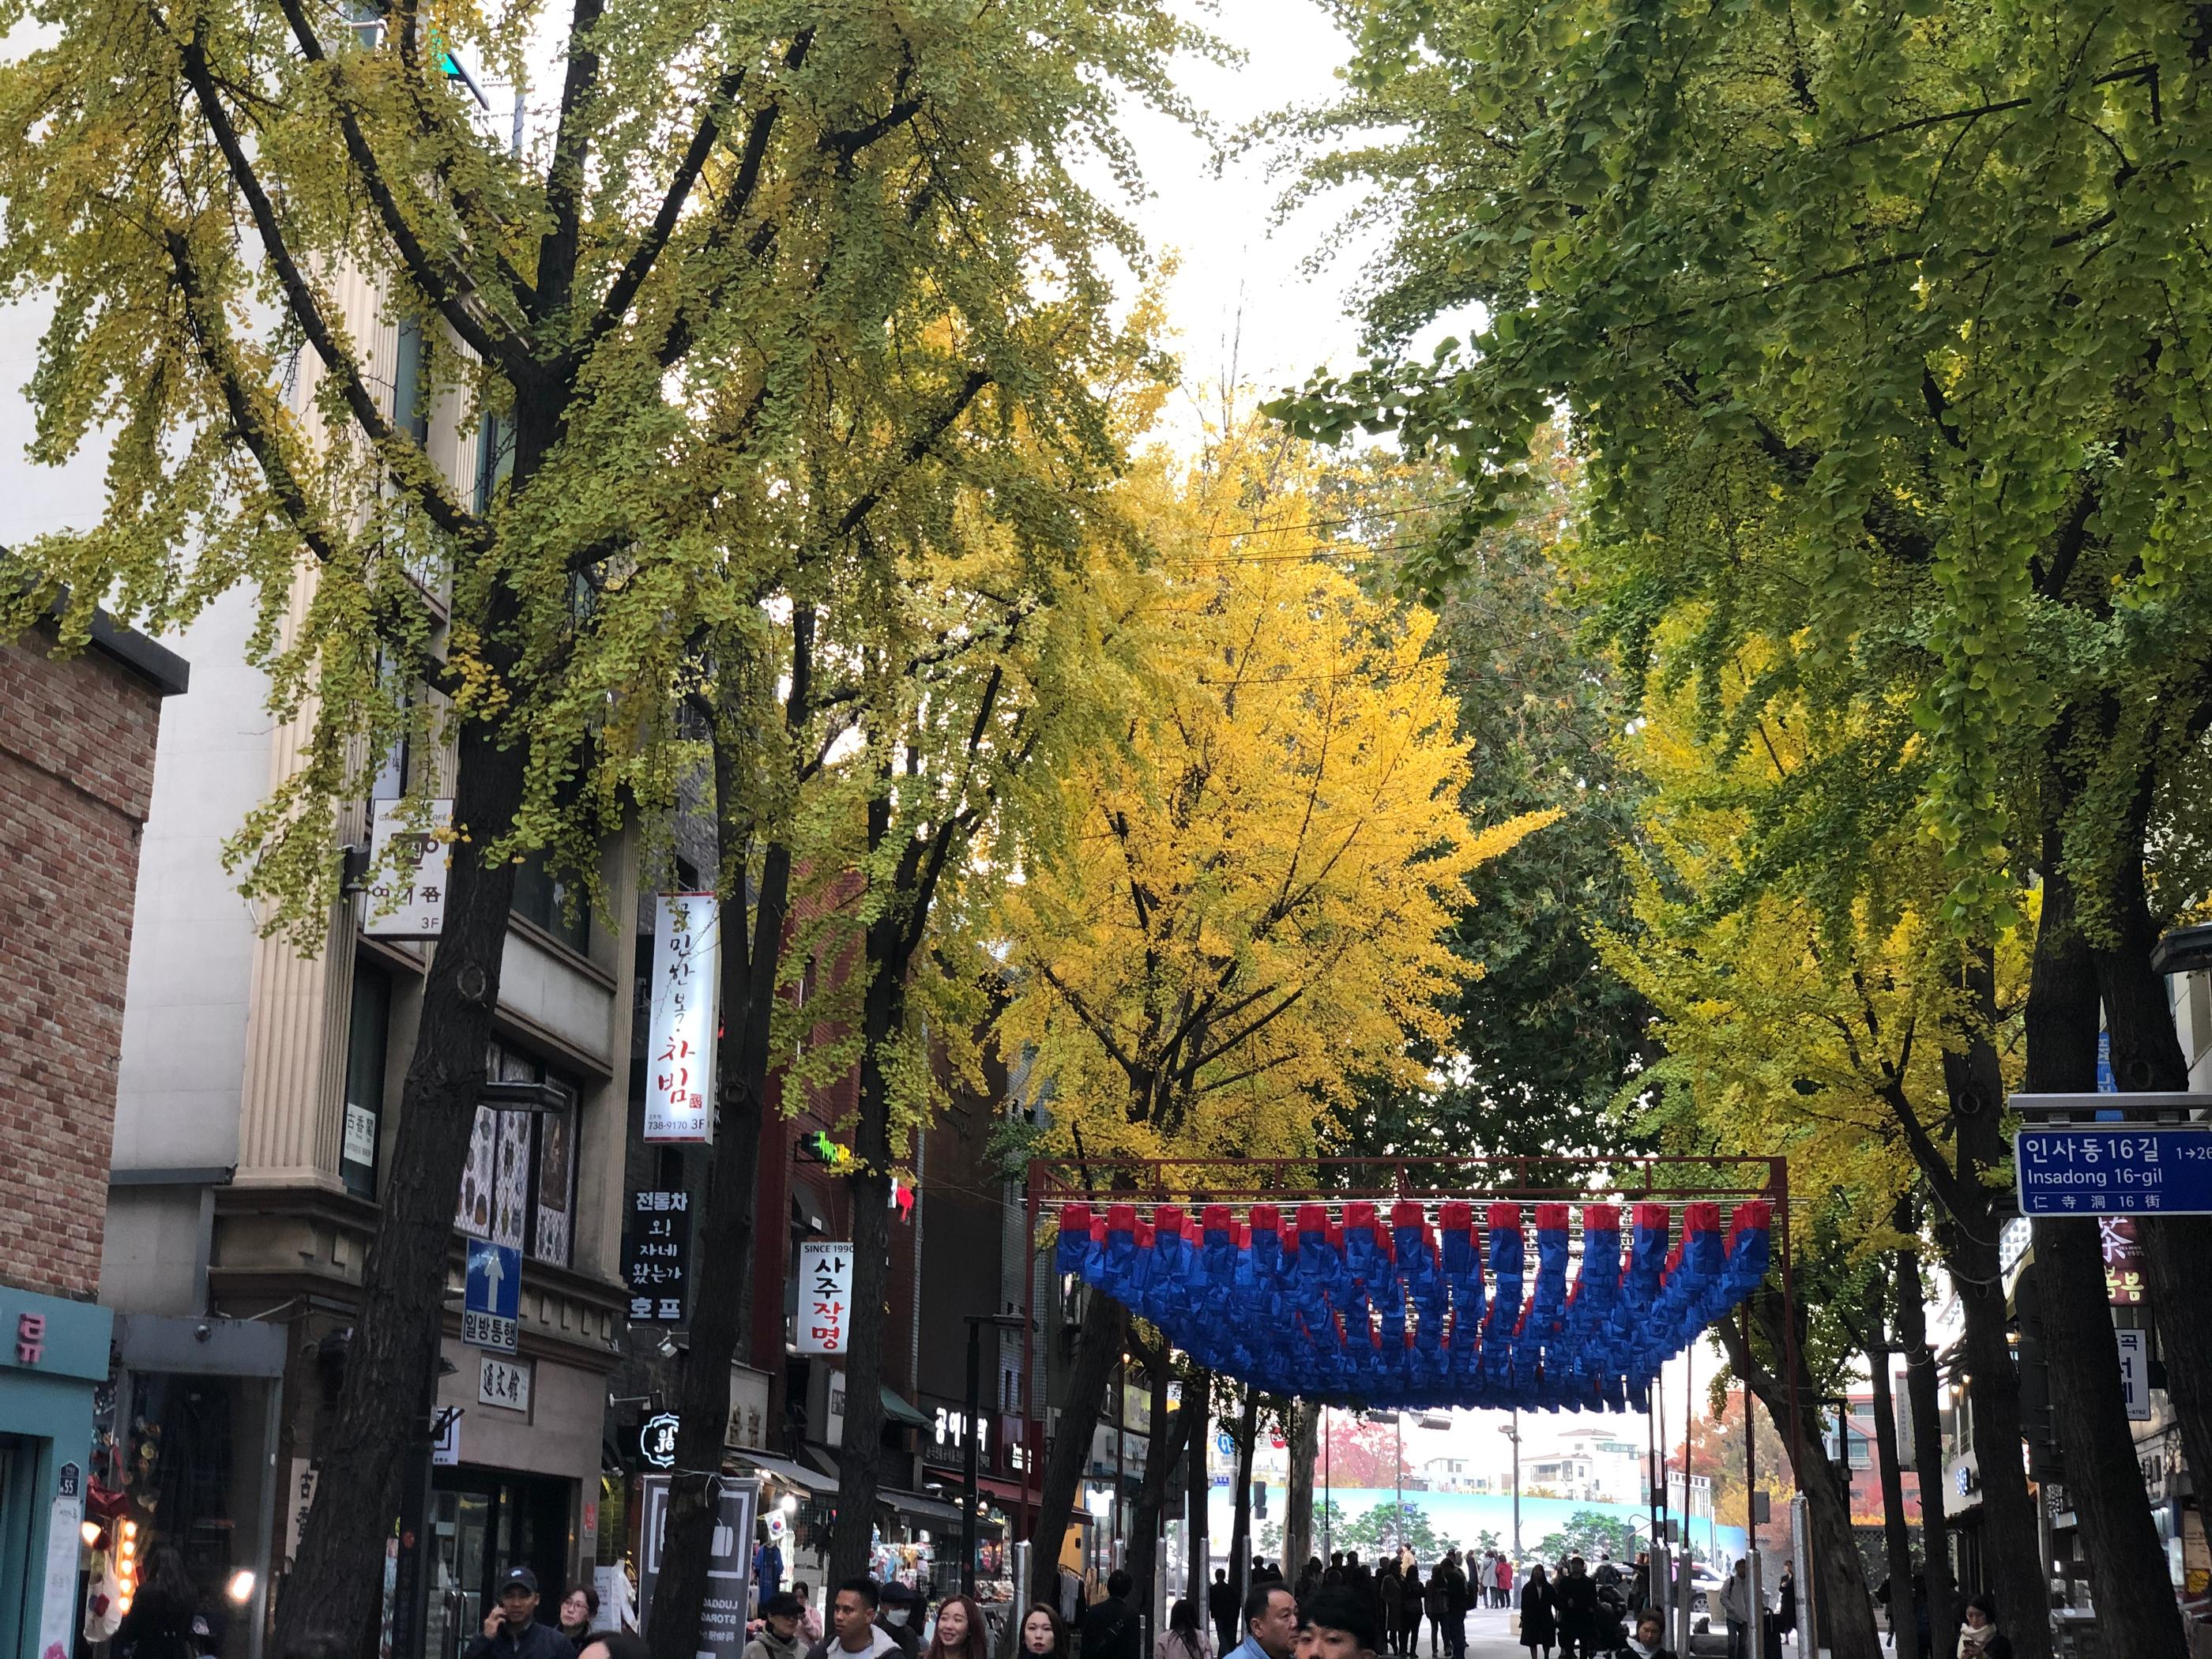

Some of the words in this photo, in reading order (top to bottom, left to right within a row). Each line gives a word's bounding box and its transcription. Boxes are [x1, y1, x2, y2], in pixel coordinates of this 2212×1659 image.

[421, 916, 439, 930] 3F
[648, 1120, 687, 1130] 738-9170
[691, 1119, 705, 1130] 3F
[2026, 1137, 2159, 1164] 인사동16길
[2027, 1168, 2107, 1187] Insadong
[2114, 1168, 2163, 1187] 16-gil
[636, 1191, 688, 1212] 전통차
[648, 1218, 672, 1237] 오!
[639, 1243, 678, 1257] 자네
[804, 1244, 830, 1253] SINCE
[632, 1262, 683, 1285] 왔는가
[466, 1314, 516, 1346] 일방통행
[64, 1479, 74, 1494] 55
